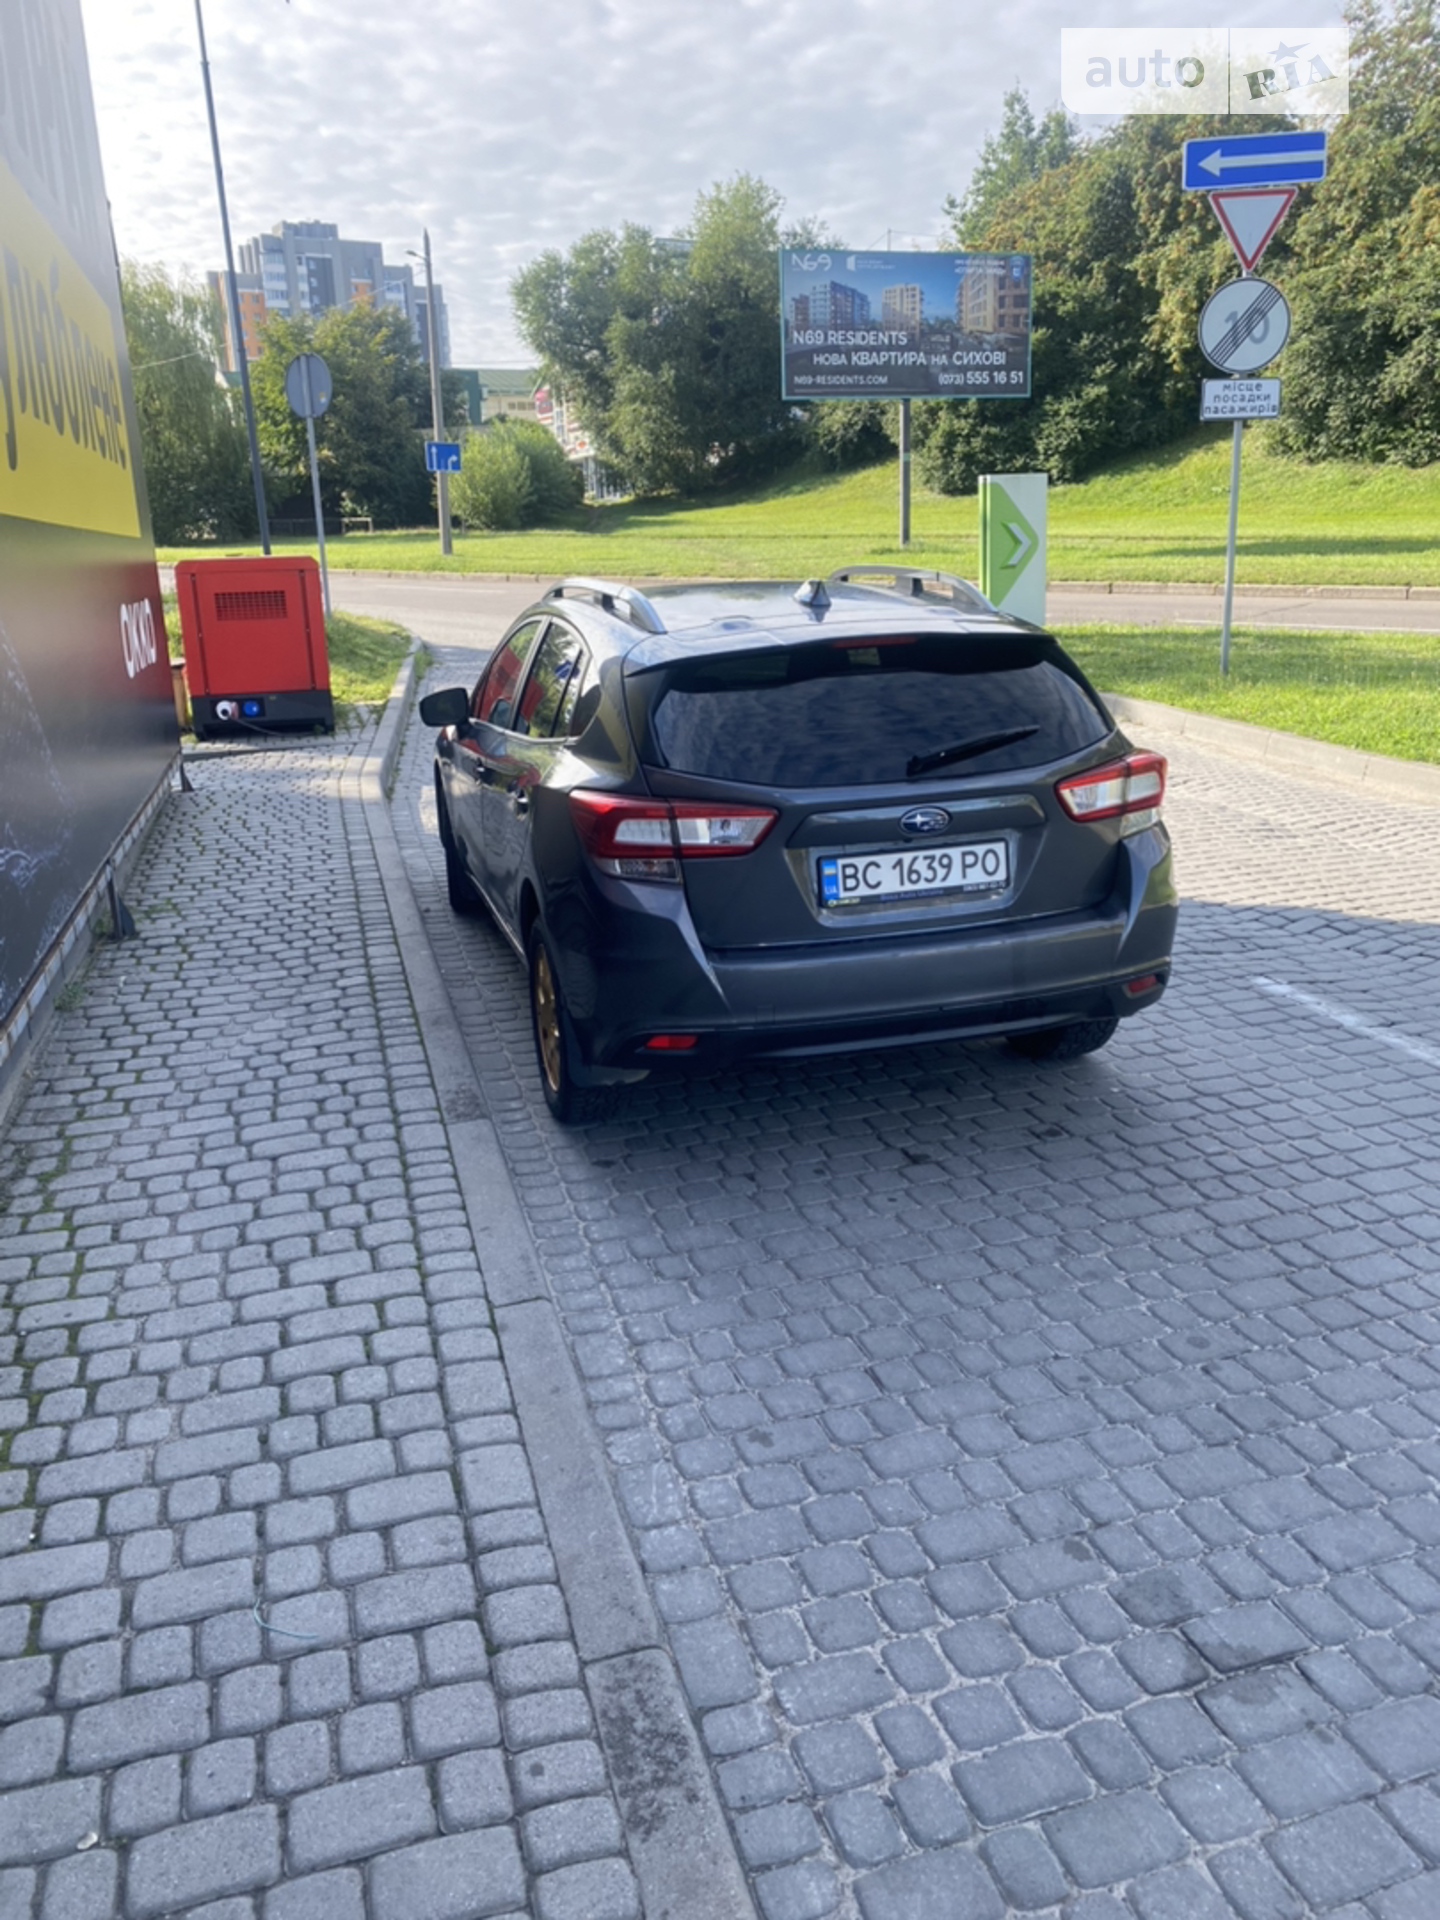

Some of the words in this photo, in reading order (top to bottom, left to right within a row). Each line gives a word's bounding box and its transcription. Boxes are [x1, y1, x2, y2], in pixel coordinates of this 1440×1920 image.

[792, 331, 824, 345] N69
[828, 331, 908, 345] RESIDENTS
[813, 354, 848, 365] НОВА
[851, 352, 926, 365] КВАРТИРА
[931, 354, 948, 365] НА
[953, 351, 1007, 365] СИХОВІ
[794, 375, 888, 385] N69-RESIDENTS.COM
[938, 373, 964, 385] (073)
[966, 371, 990, 384] 555
[993, 371, 1007, 383] 16
[1009, 371, 1024, 383] 51
[1222, 381, 1263, 392] місце
[1213, 393, 1271, 403] посадки
[1204, 404, 1278, 415] пасажирів
[120, 598, 156, 679] OKKO
[841, 861, 882, 892] BC
[892, 853, 953, 886] 1639
[961, 848, 1000, 879] PO
